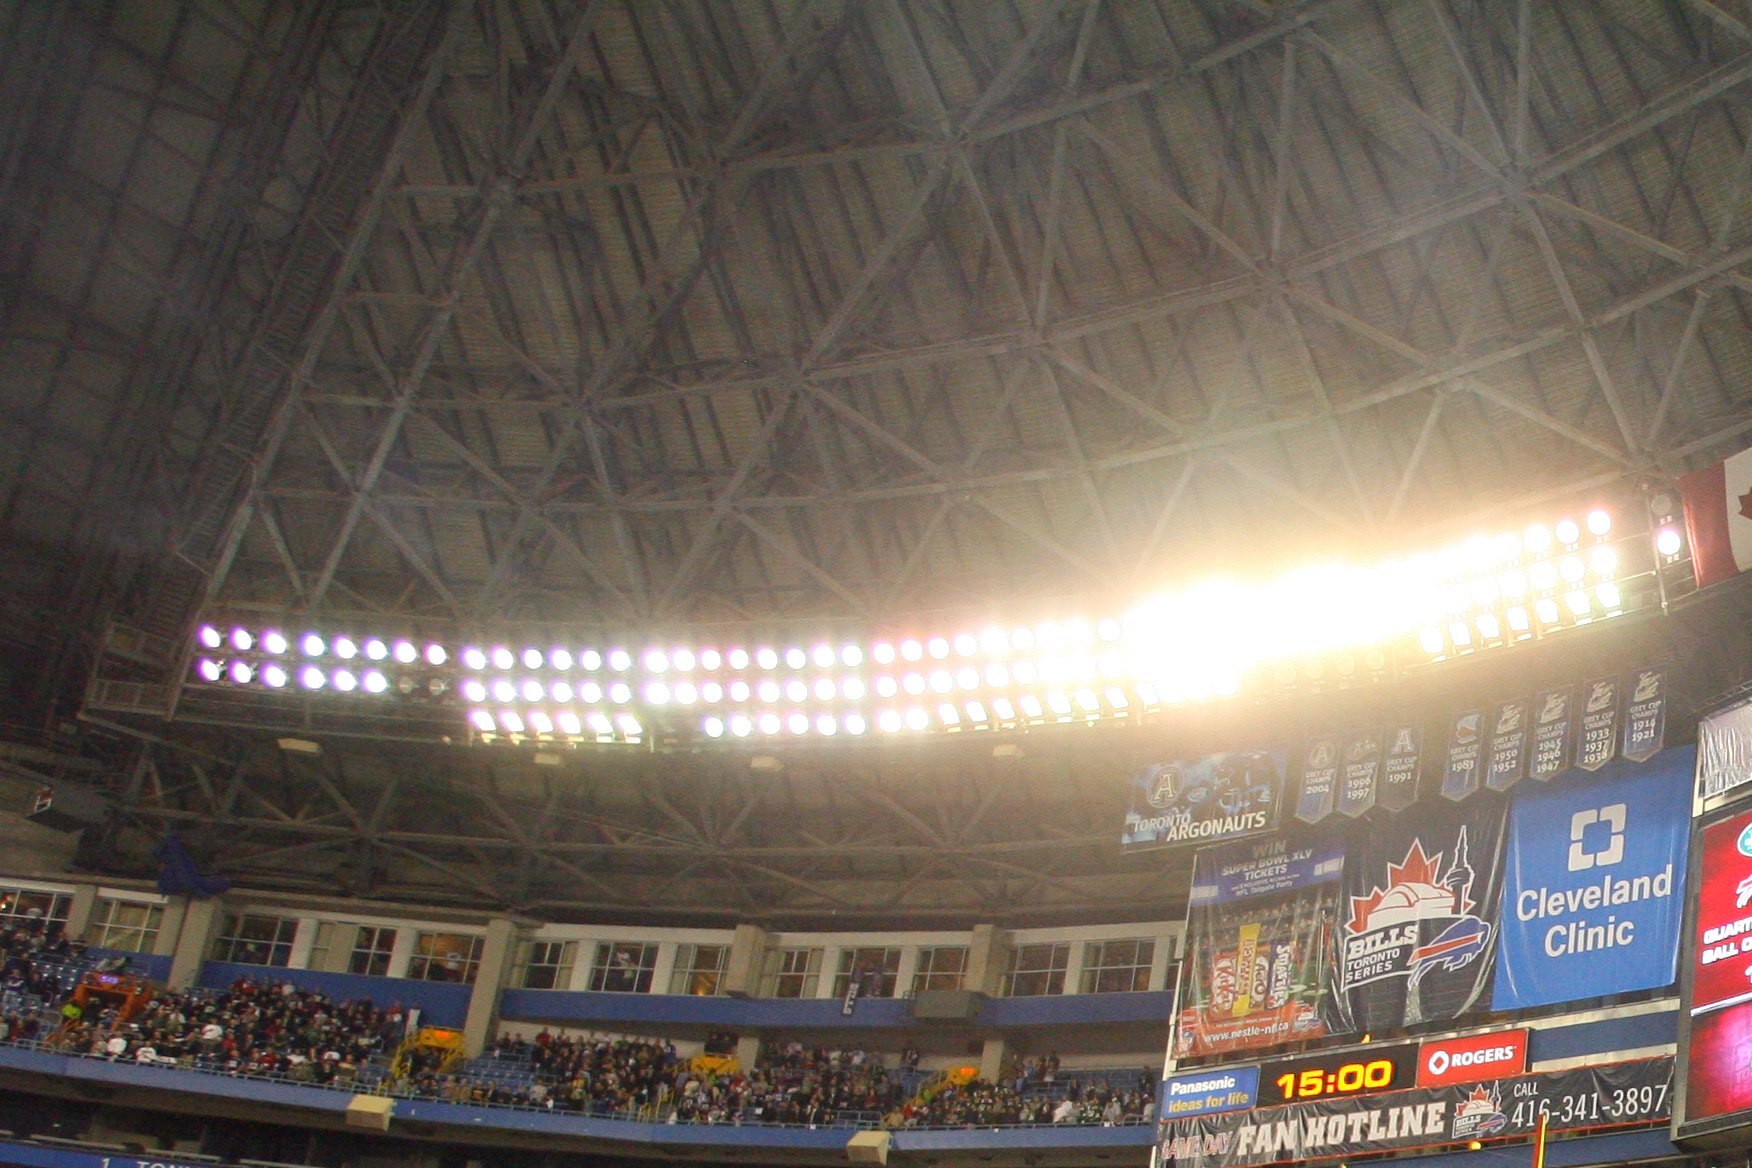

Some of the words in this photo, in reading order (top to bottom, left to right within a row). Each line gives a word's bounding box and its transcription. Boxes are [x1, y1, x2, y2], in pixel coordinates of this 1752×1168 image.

[1133, 813, 1191, 832] TORONTO
[1167, 811, 1266, 842] ARGONAUTS
[1222, 860, 1256, 876] SUPER
[1259, 853, 1289, 869] BOWL
[1245, 864, 1288, 881] TICKETS
[1516, 864, 1672, 923] Cleveland
[1348, 924, 1418, 960] BILLS
[1543, 916, 1635, 959] Clinic
[1346, 948, 1400, 971] TORONTO
[1702, 943, 1739, 965] BALL
[1345, 961, 1392, 983] SERIES
[1204, 1022, 1289, 1043] www.nestle-nfl.ca
[1451, 1045, 1514, 1067] ROGERS
[1170, 1075, 1236, 1096] Panasonic
[1276, 1059, 1395, 1099] 15:00
[1514, 1081, 1539, 1098] CALL
[1168, 1097, 1203, 1113] ideas
[1205, 1096, 1225, 1107] for
[1227, 1092, 1249, 1106] life
[1512, 1083, 1667, 1128] 416-341-3897
[1236, 1119, 1298, 1156] FAN
[1304, 1101, 1446, 1147] HOTLINE
